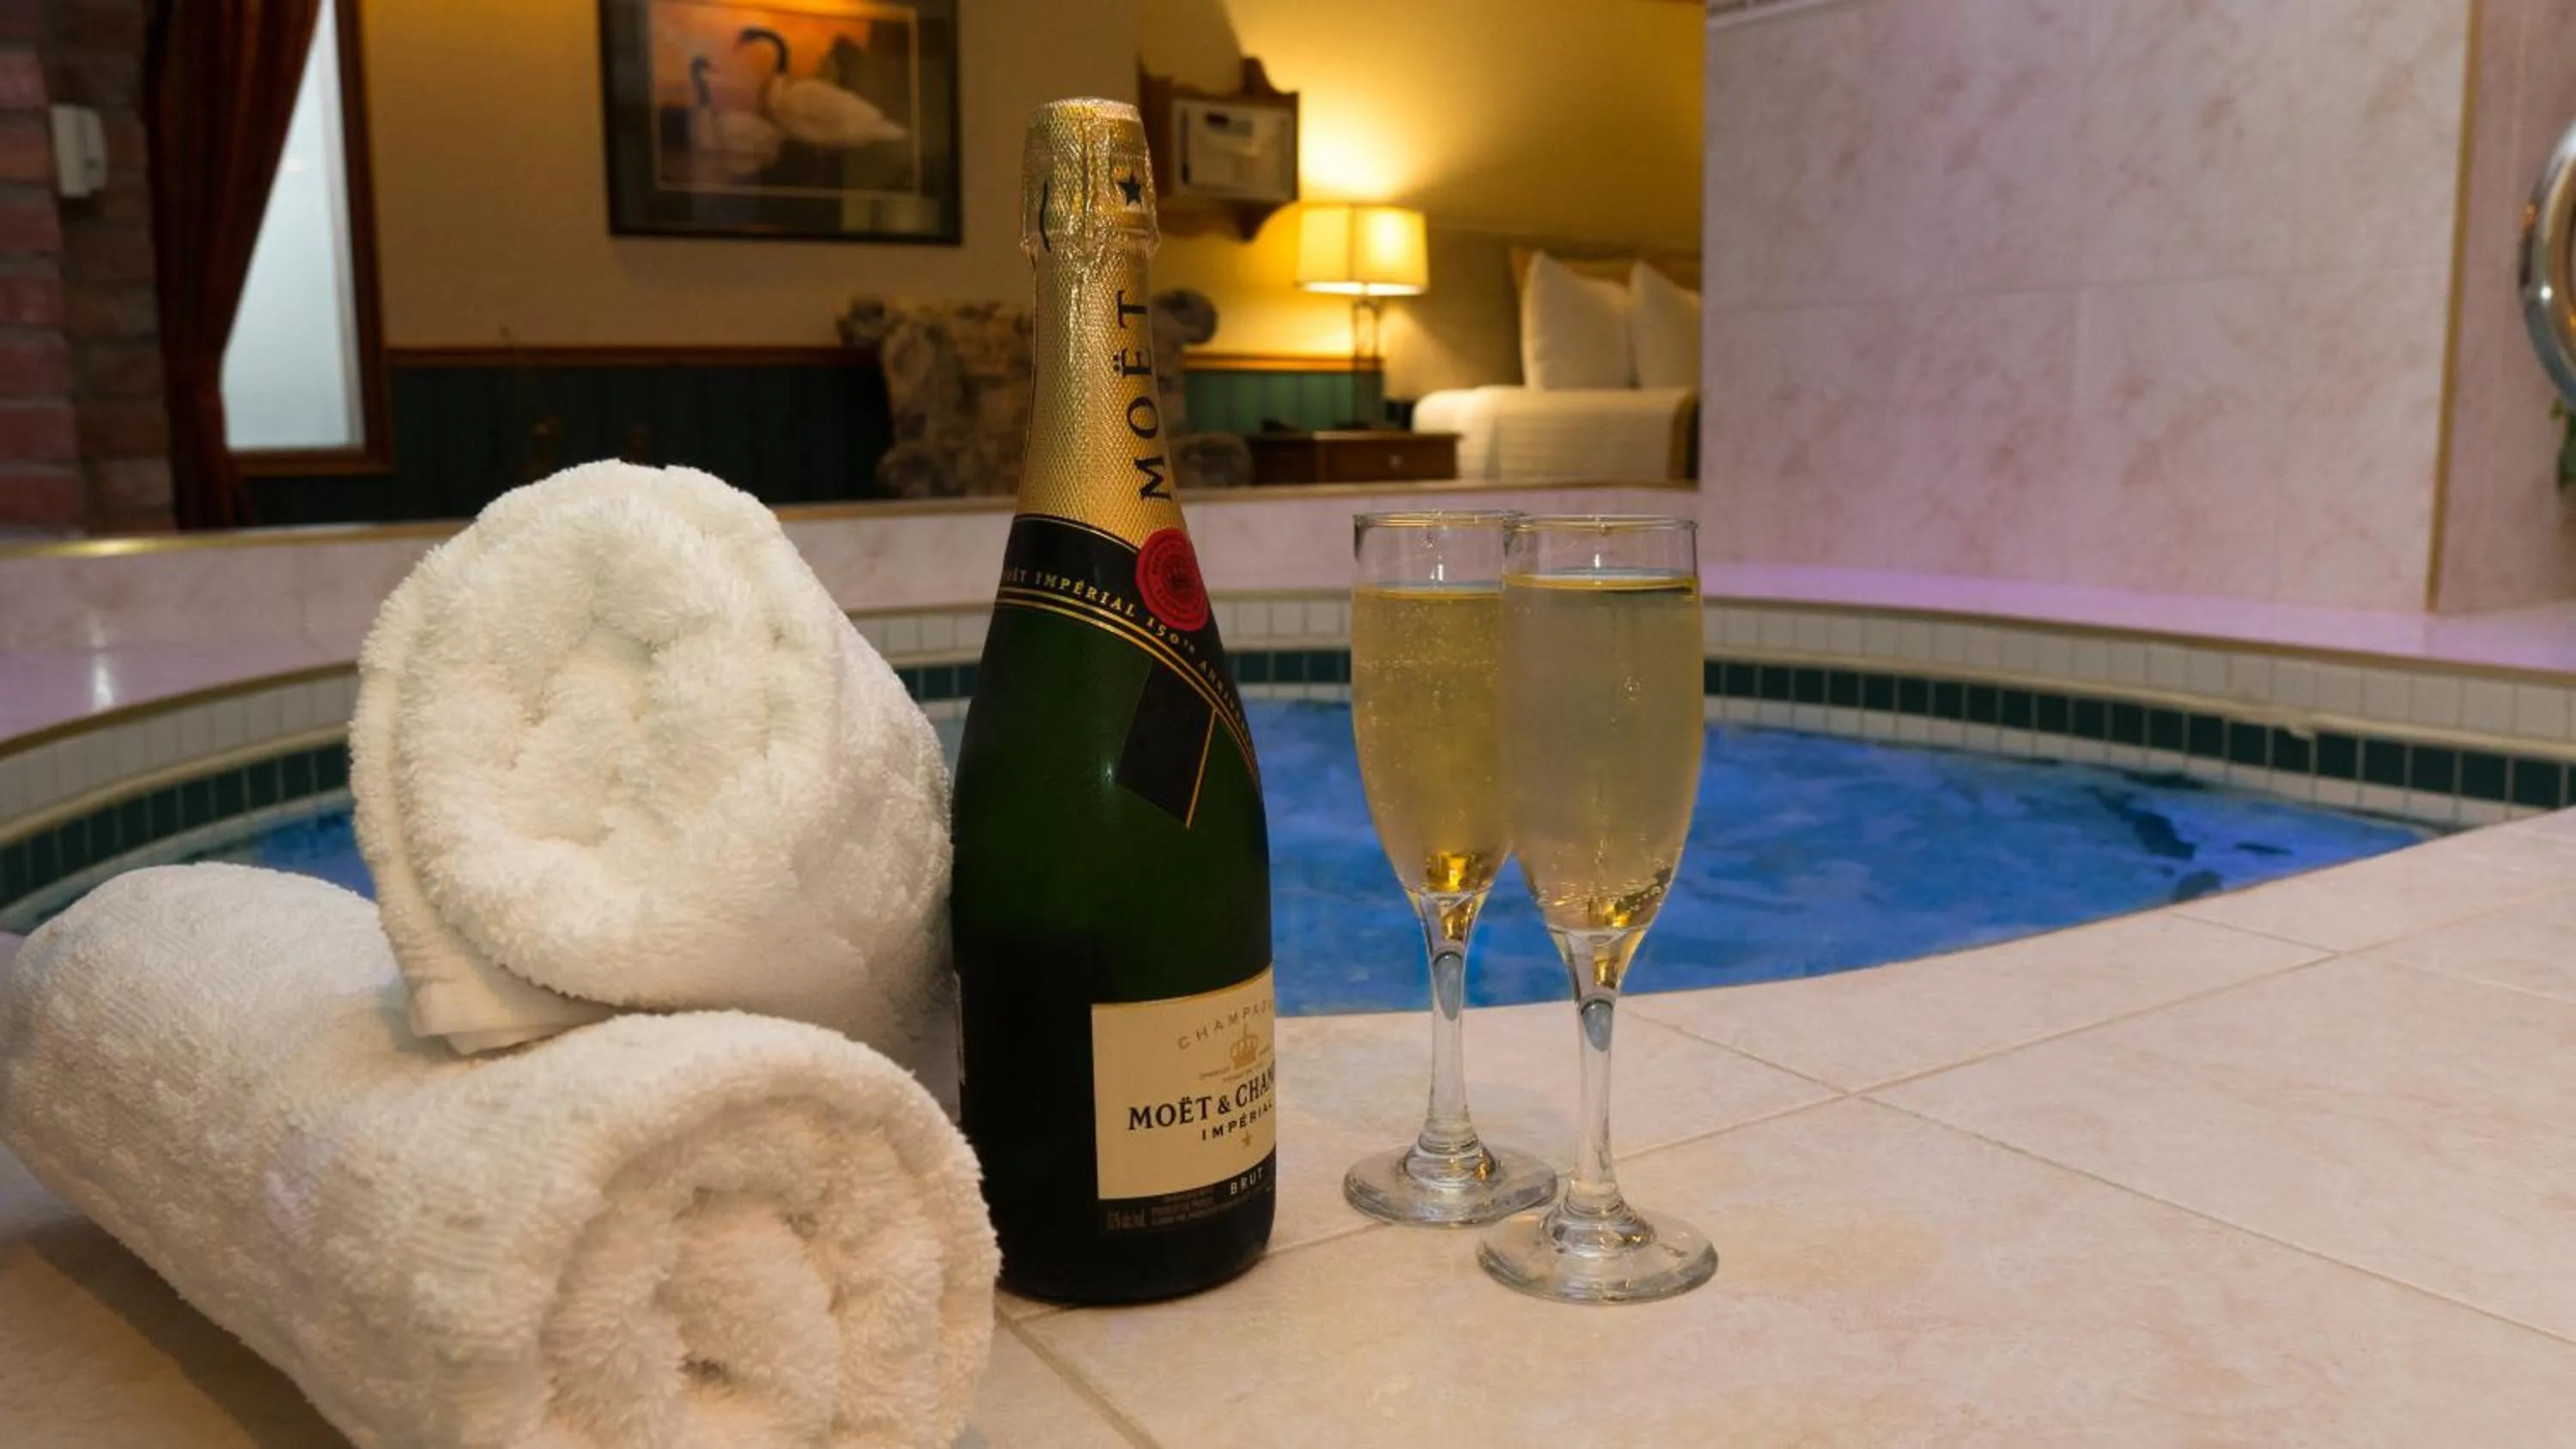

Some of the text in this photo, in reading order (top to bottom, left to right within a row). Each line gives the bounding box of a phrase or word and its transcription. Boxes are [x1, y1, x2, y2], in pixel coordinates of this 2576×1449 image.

[1113, 289, 1171, 502] MOËT
[1036, 570, 1135, 617] IMPÉRIAL
[1127, 1095, 1212, 1131] MOËT
[1218, 1095, 1231, 1115] &
[1230, 1167, 1264, 1197] BRUT
